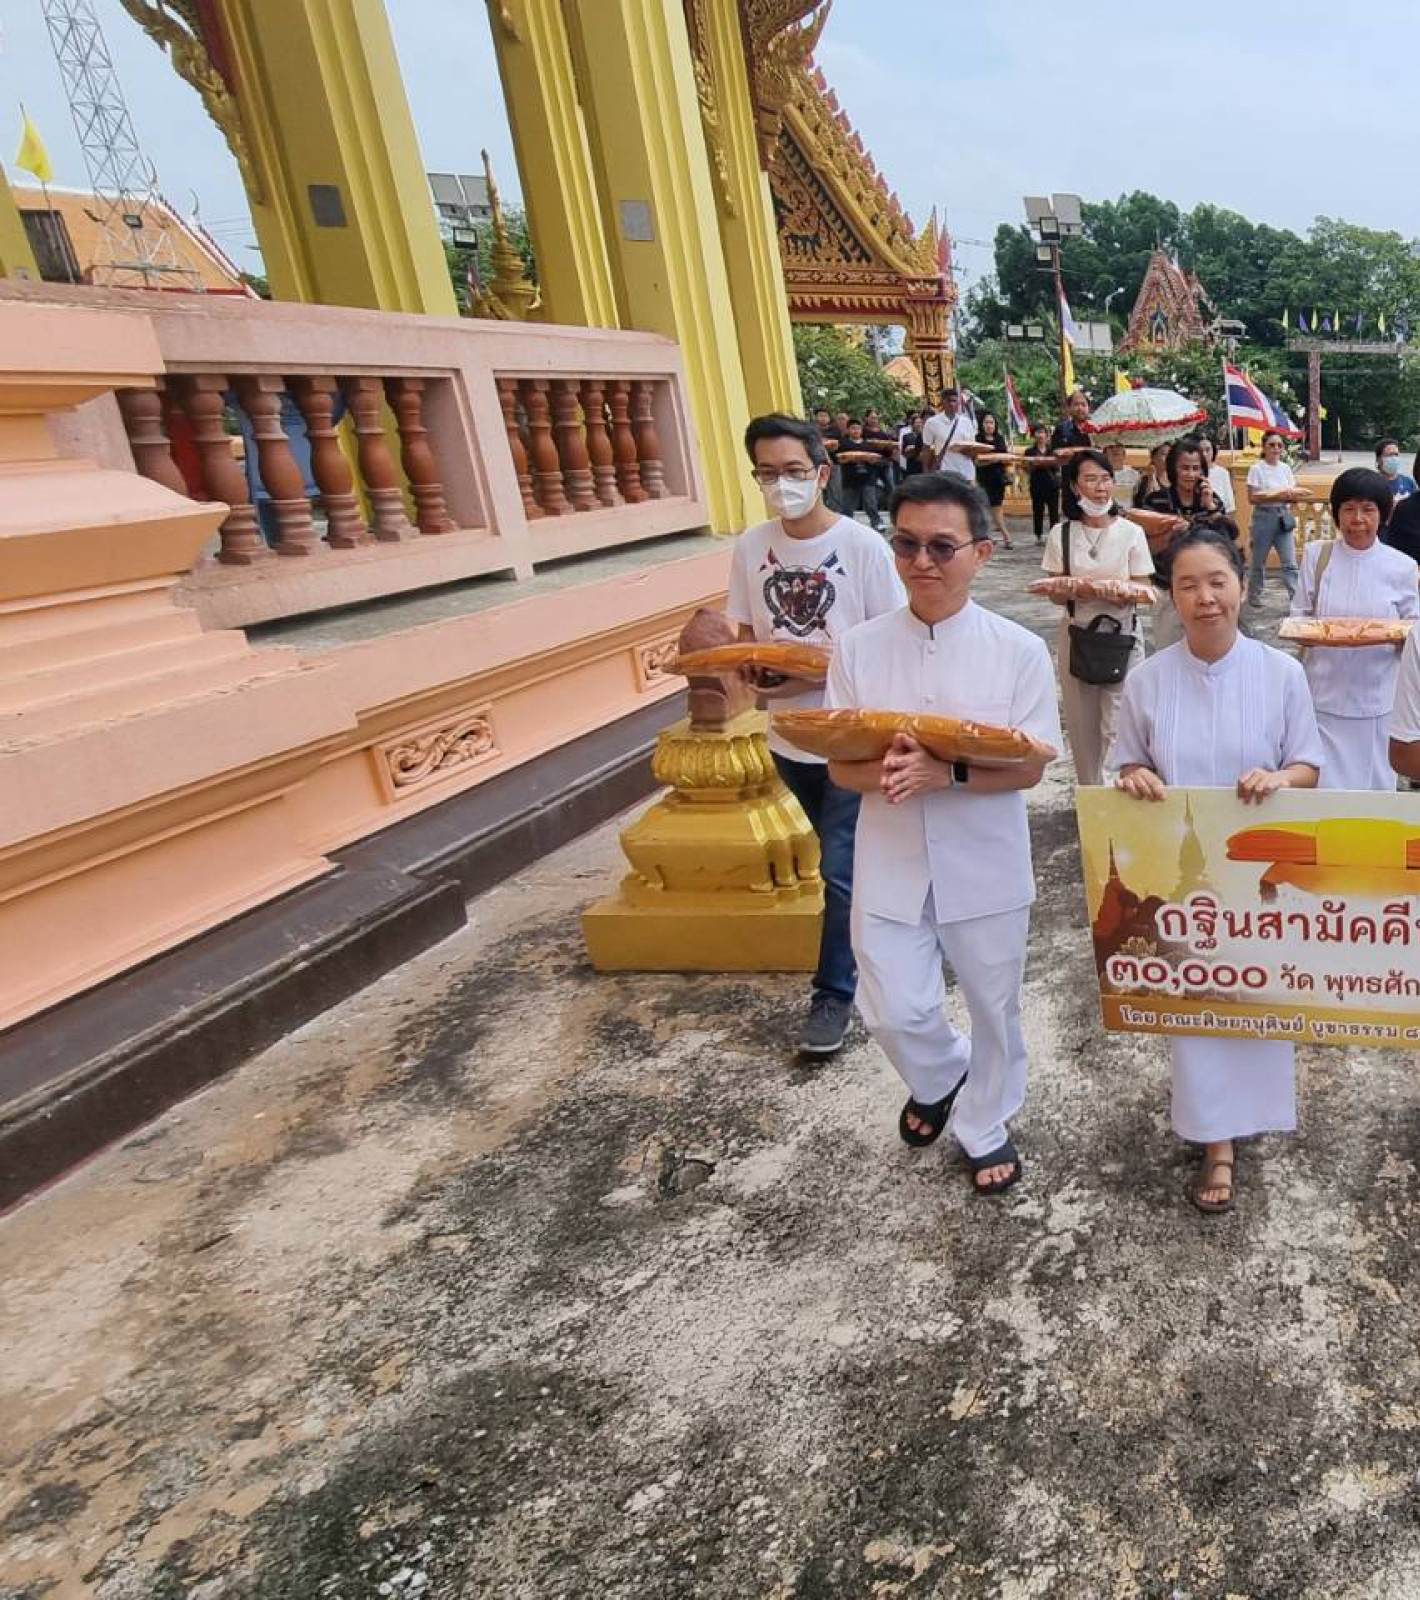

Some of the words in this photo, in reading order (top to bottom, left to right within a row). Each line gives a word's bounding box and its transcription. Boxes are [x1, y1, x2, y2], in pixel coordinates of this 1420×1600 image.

[1112, 958, 1268, 990] ๓๐,๐๐๐
[1280, 963, 1315, 991] วัด
[1121, 1005, 1156, 1025] โดย
[1162, 1011, 1304, 1035] คณะศิษยานุศิษย์
[1311, 1020, 1398, 1039] บูชาธรรม
